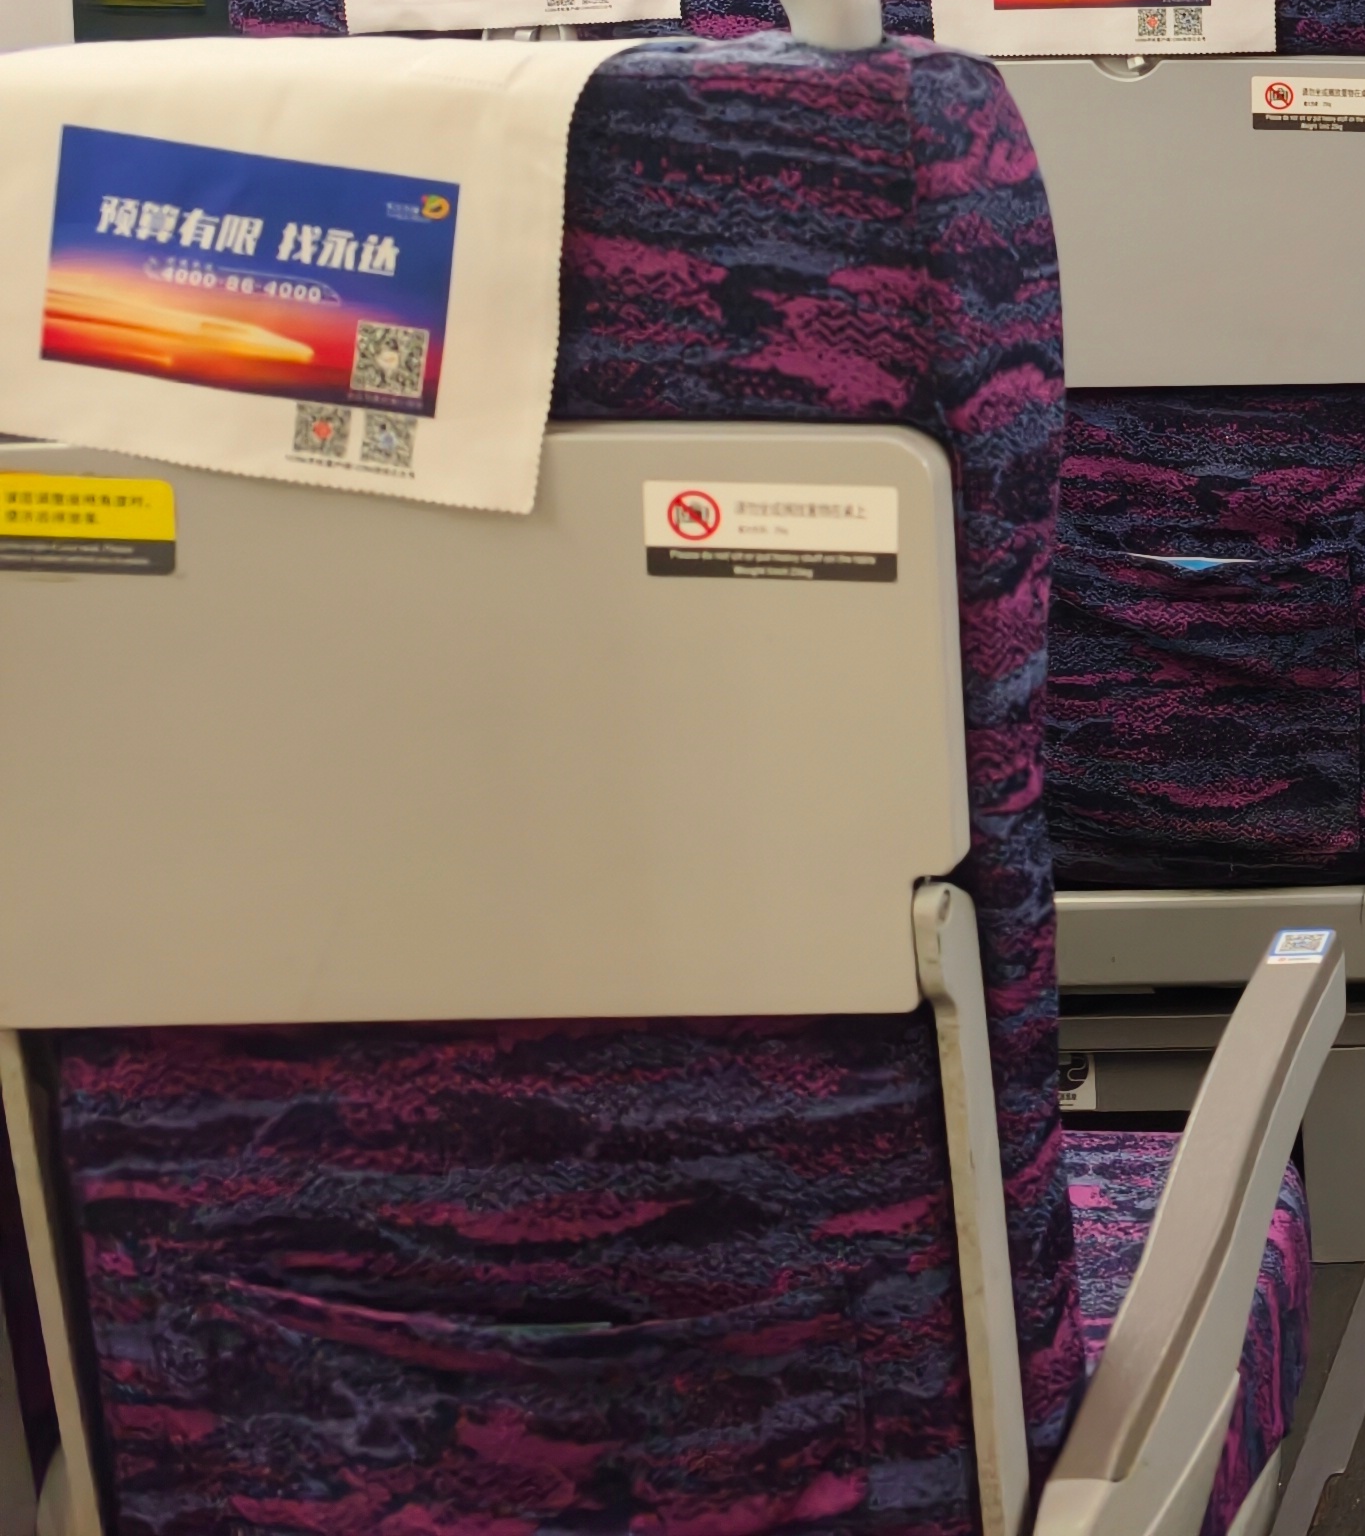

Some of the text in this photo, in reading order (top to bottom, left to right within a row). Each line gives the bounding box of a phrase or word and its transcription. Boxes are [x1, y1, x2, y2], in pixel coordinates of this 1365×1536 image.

[97, 196, 399, 275] 预算有限 找永达
[160, 268, 323, 304] 4000-86-4000
